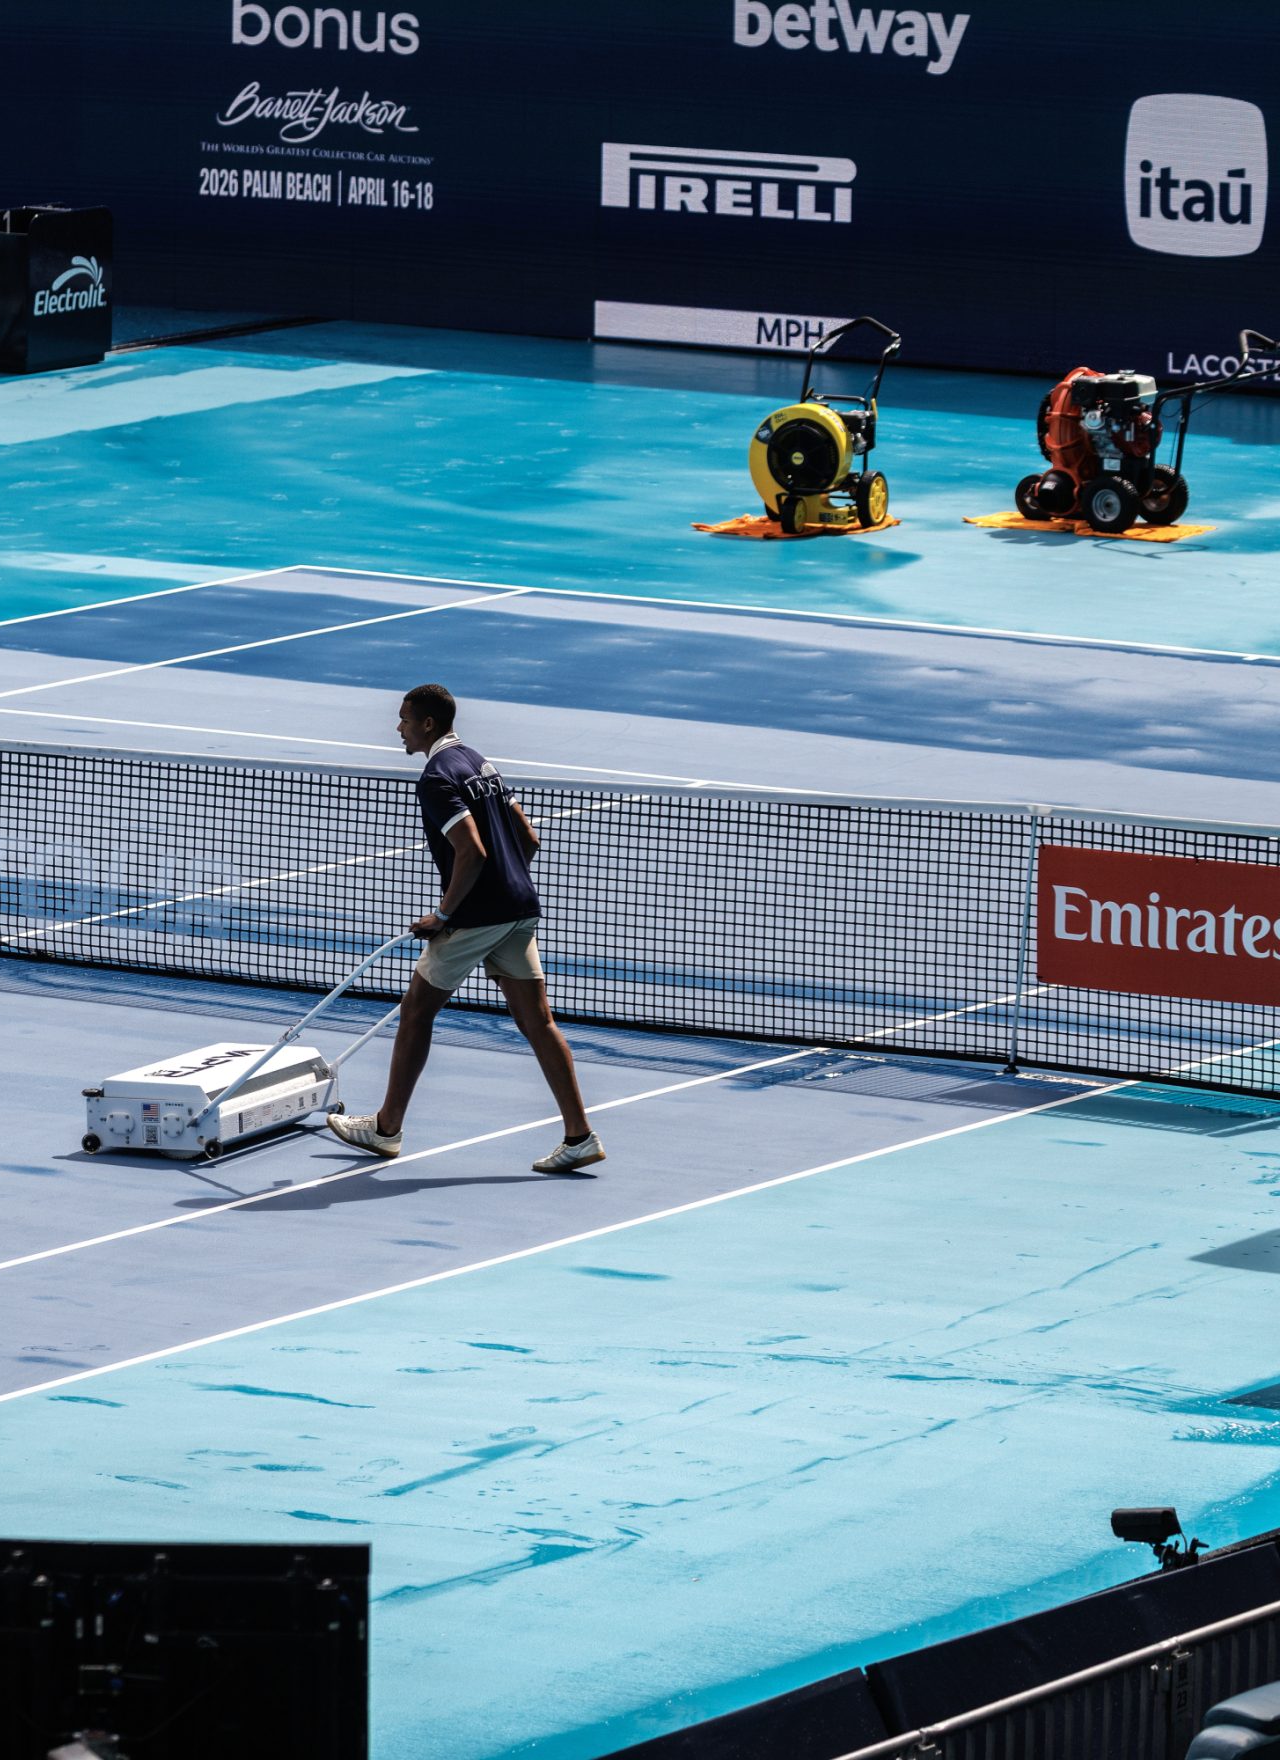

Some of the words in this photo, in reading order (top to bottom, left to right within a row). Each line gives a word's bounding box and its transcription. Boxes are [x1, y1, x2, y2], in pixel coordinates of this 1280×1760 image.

[232, 0, 420, 55] bonus
[734, 0, 970, 75] betway
[217, 81, 419, 141] Barrett-Jackson
[200, 168, 239, 197] 2026
[243, 169, 282, 199] PALM
[286, 171, 331, 202] BEACH
[348, 176, 388, 206] APRIL
[392, 180, 434, 210] 16-18
[601, 142, 857, 223] PIRELLI
[1140, 160, 1252, 225] itaú
[34, 283, 106, 316] Electrolit
[756, 317, 823, 348] MPH
